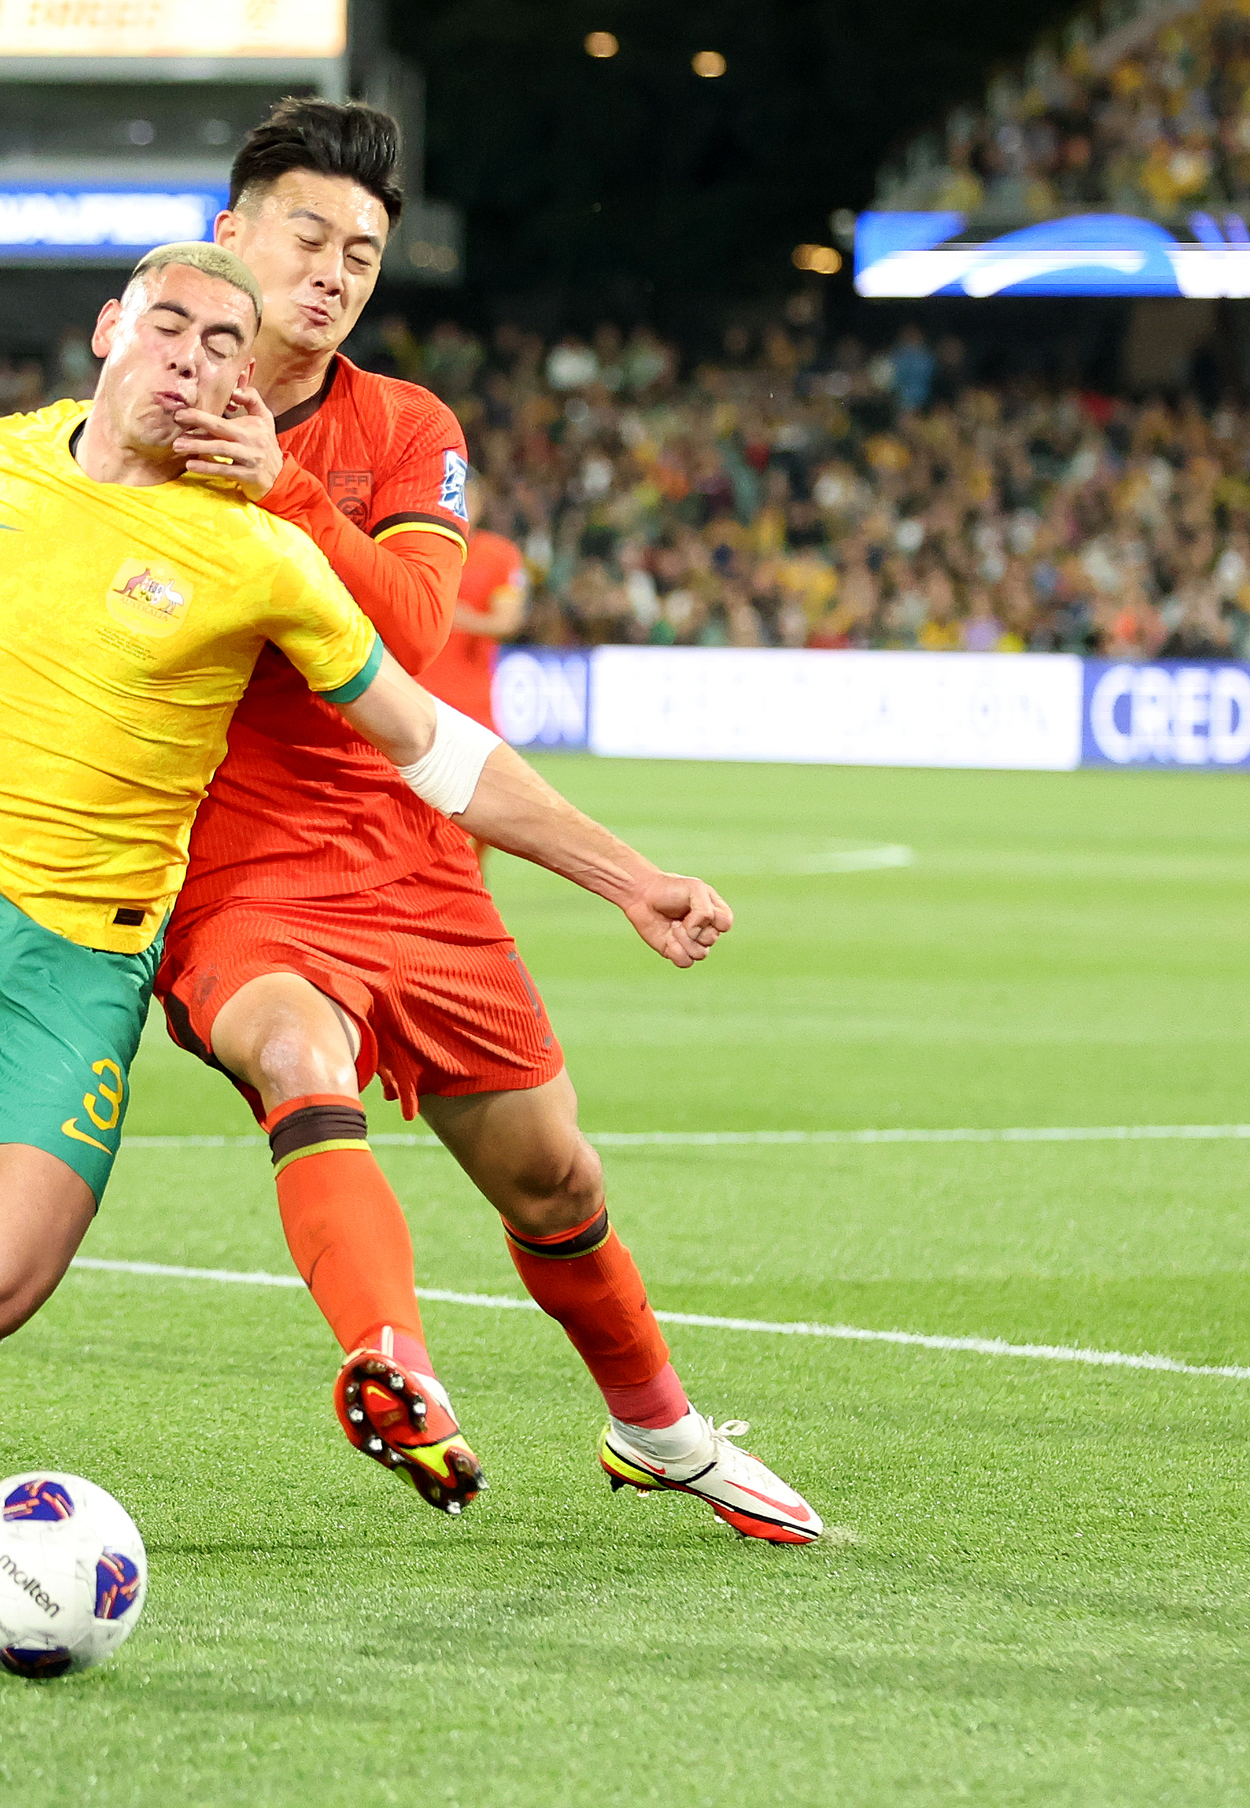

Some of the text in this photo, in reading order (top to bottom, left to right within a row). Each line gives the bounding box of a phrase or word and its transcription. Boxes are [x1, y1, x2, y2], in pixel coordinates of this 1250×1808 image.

[333, 475, 368, 487] CFA
[120, 596, 169, 622] AUSTRALIA
[83, 1058, 123, 1131] 3
